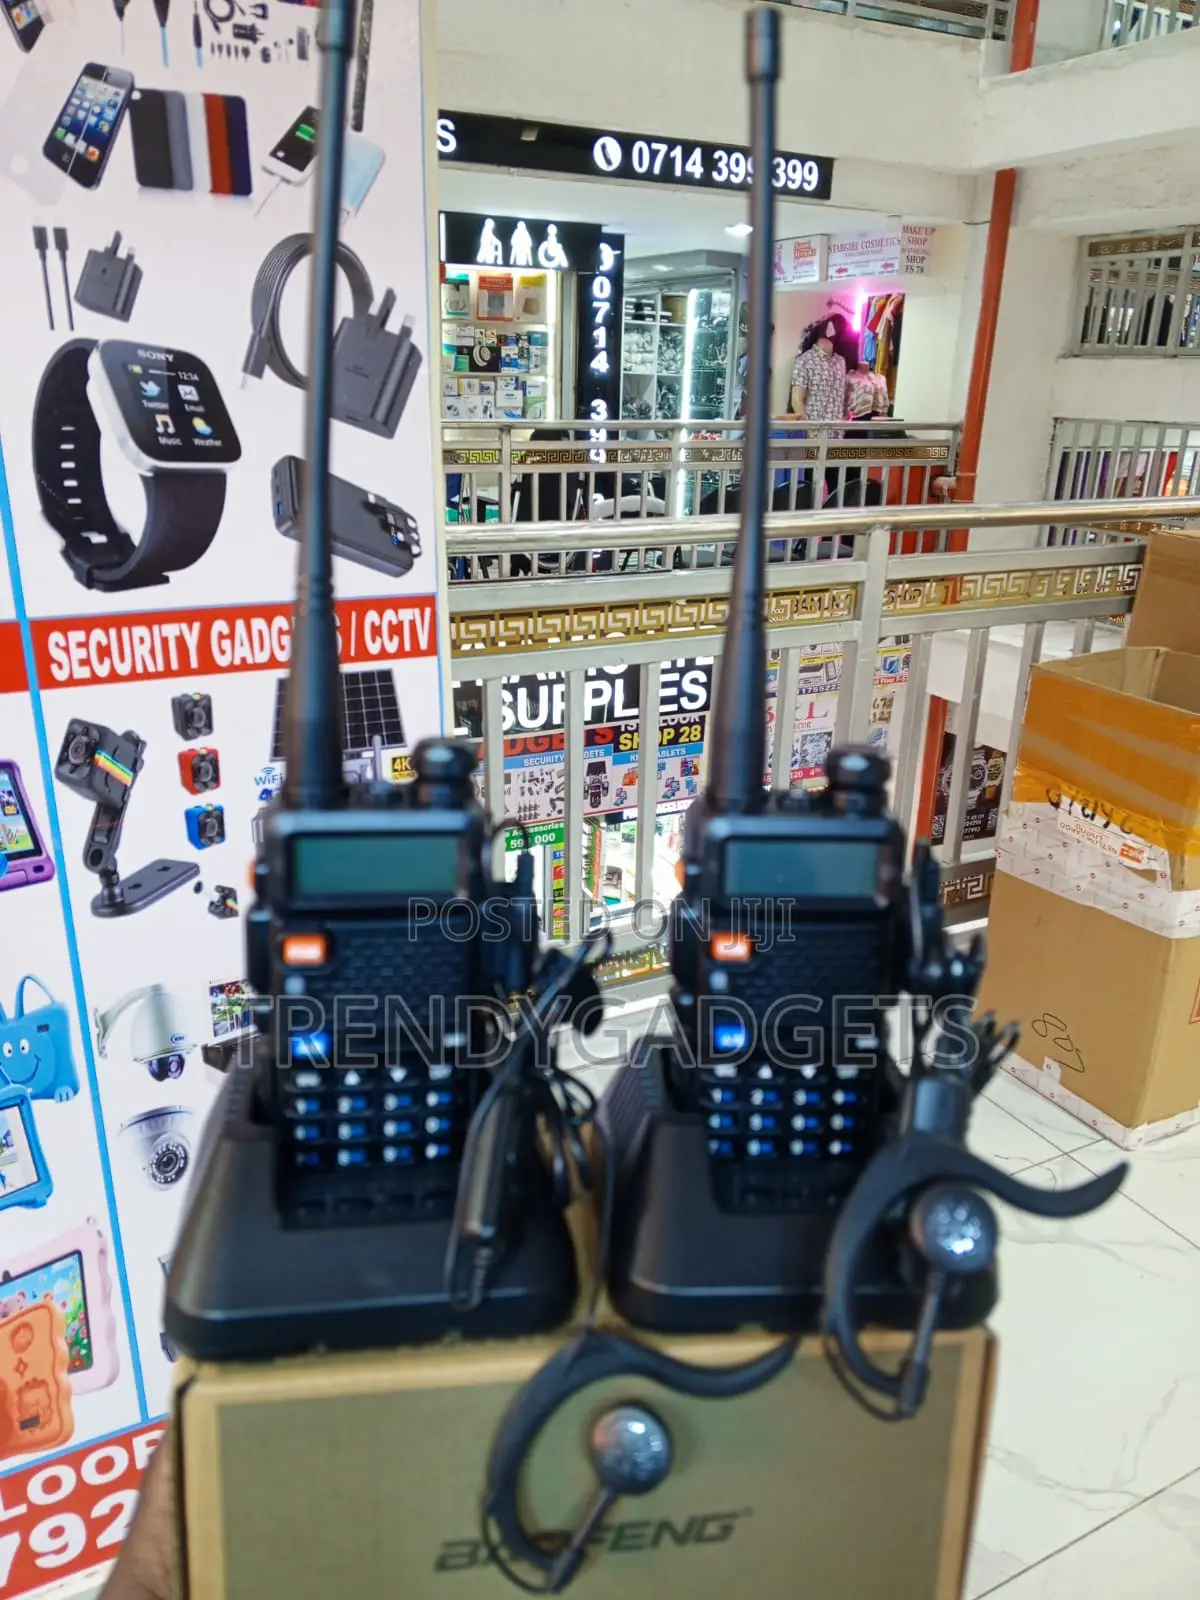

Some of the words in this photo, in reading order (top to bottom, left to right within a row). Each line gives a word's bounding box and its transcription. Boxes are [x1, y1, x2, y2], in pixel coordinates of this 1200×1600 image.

[631, 142, 703, 179] 0714
[771, 158, 819, 192] 399
[907, 236, 928, 246] SHOP
[906, 255, 926, 265] SHOP
[137, 349, 174, 362] SONY
[47, 620, 202, 682] SECURITY
[363, 606, 432, 655] CCTV
[678, 724, 702, 743] 28
[393, 757, 412, 772] 4K
[523, 754, 565, 768] SECURITY
